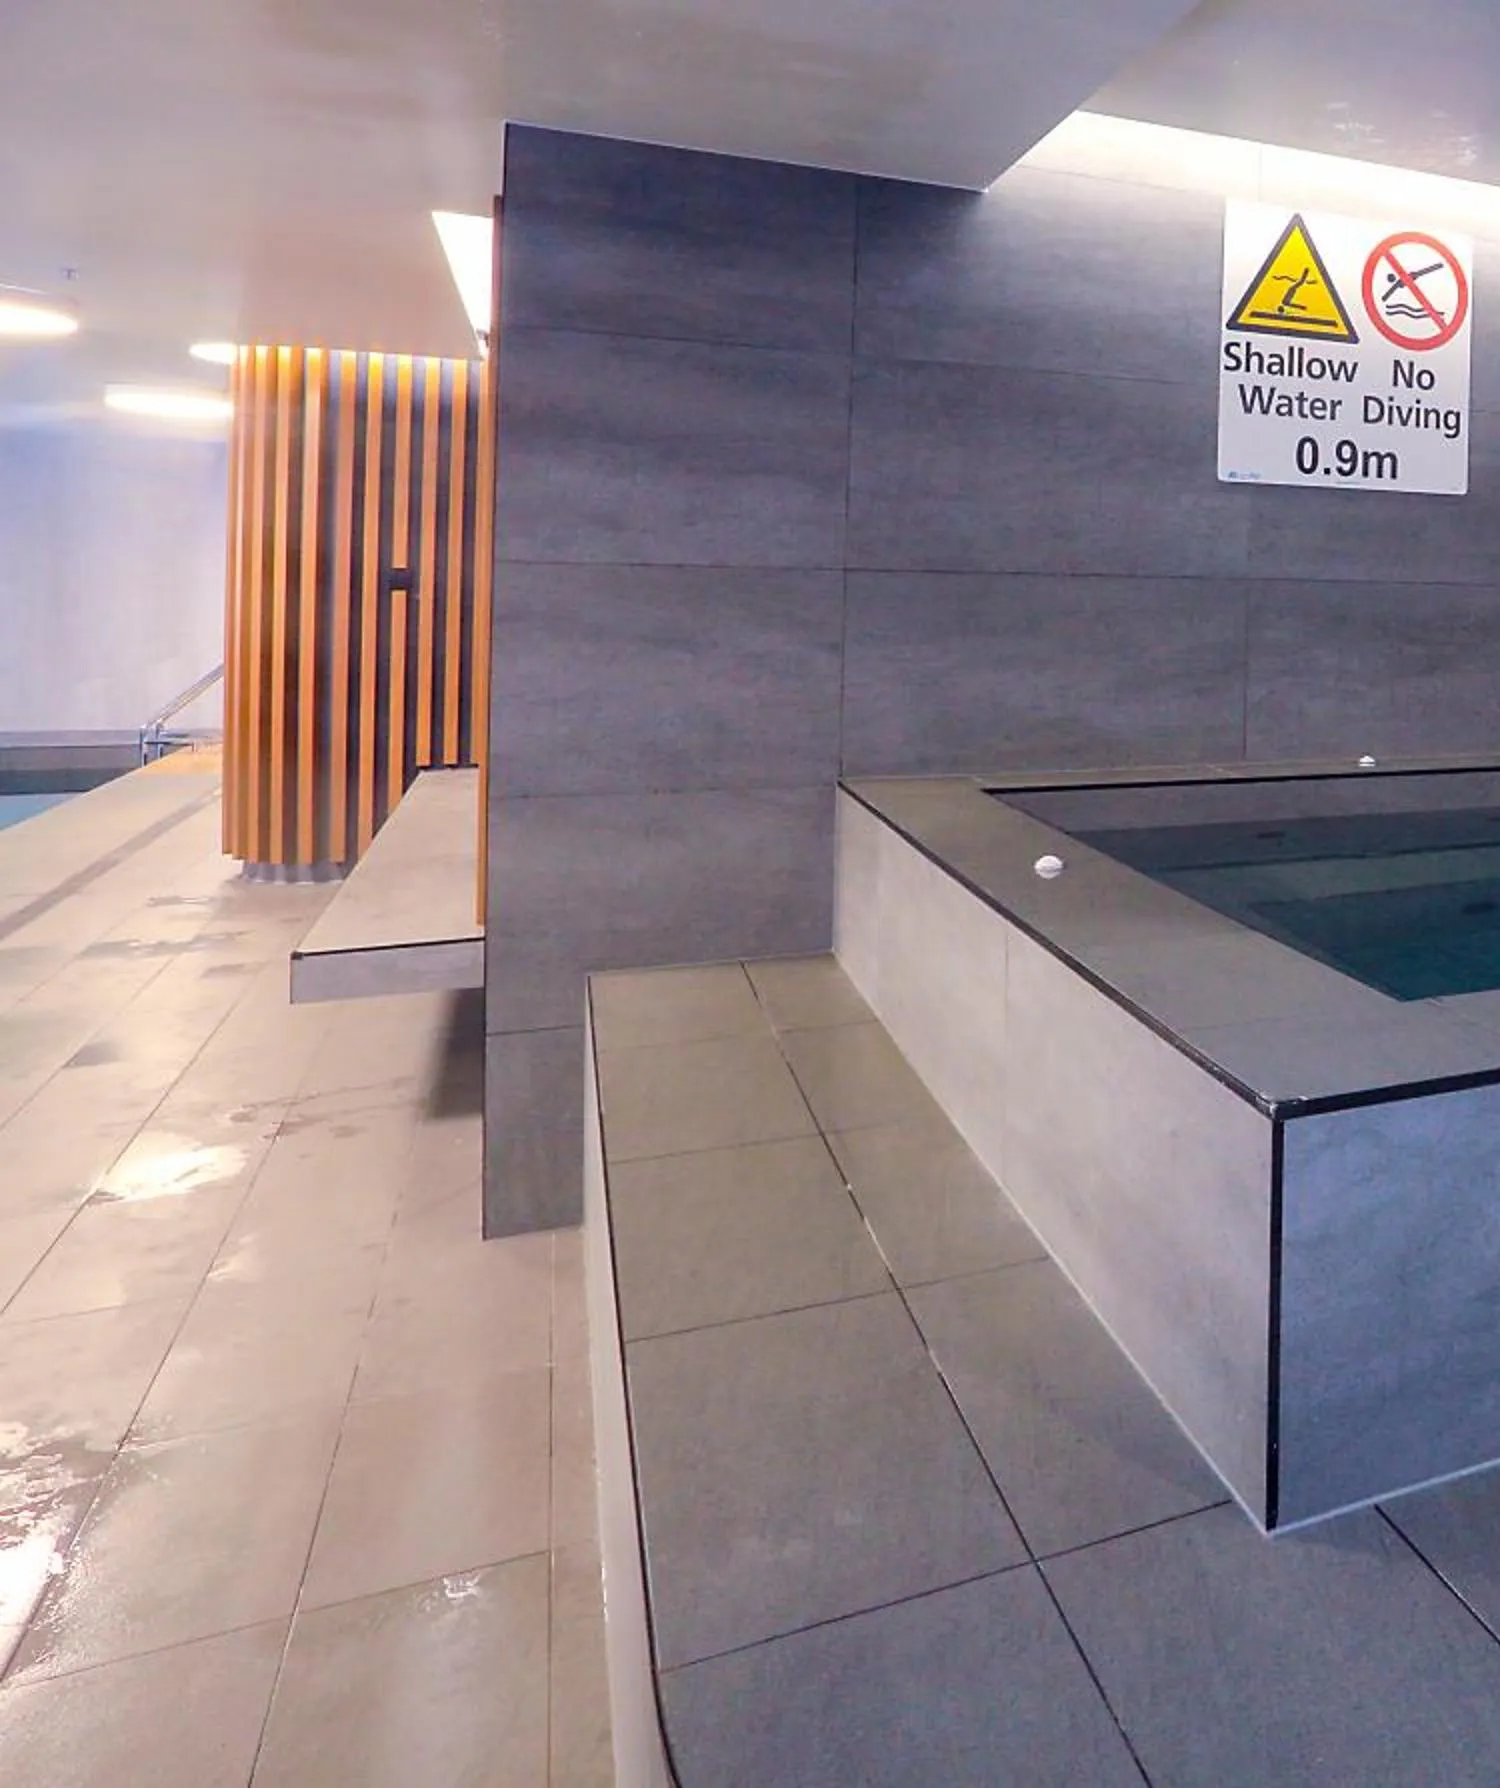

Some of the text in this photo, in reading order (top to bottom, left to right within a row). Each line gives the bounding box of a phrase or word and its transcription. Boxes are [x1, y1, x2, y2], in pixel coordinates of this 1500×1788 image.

[1223, 341, 1359, 382] Shallow
[1392, 359, 1435, 390] No
[1238, 384, 1343, 421] Water
[1363, 395, 1461, 439] Diving
[1296, 436, 1398, 480] 0.9m
